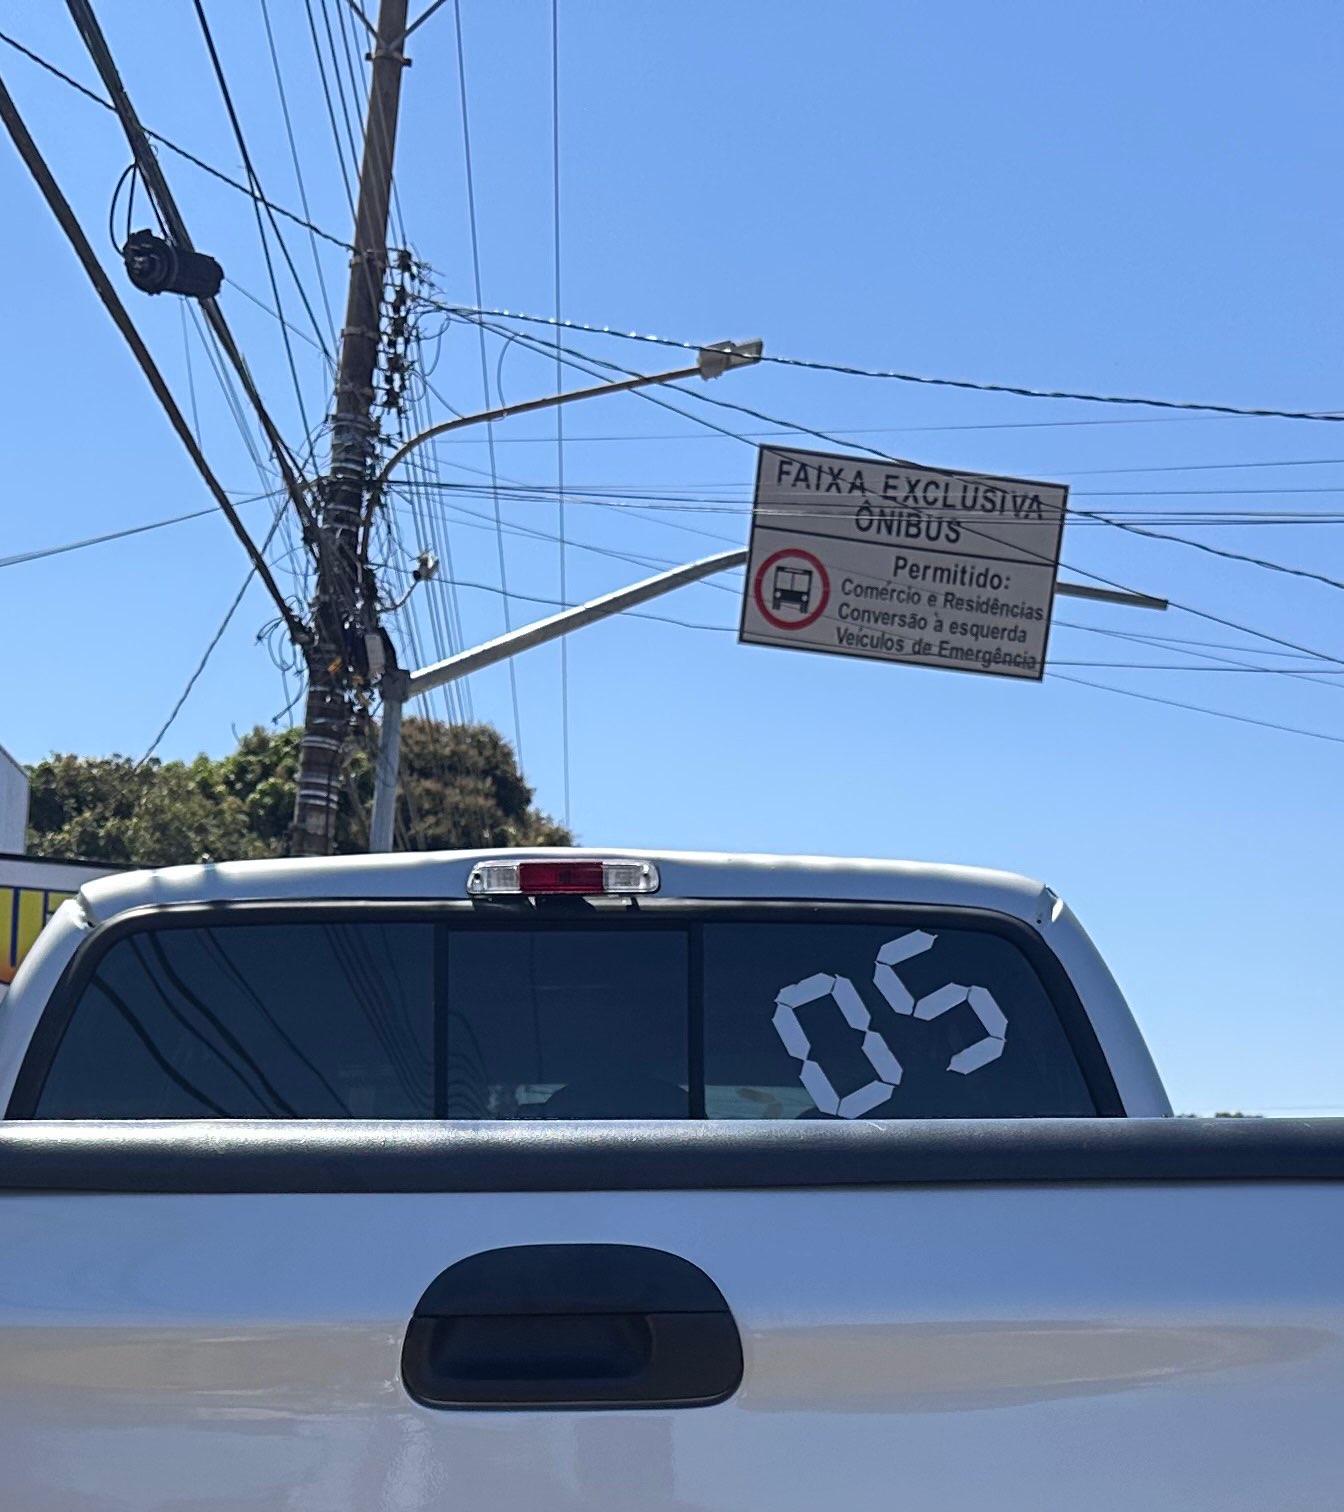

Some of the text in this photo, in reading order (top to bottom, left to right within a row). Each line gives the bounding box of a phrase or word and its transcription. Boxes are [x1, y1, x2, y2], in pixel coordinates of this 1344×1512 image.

[777, 459, 1043, 520] FAIXA EXCLUSIVA
[855, 499, 961, 543] ÔNIBUS
[893, 555, 1011, 590] Permitido:
[841, 578, 1044, 621] Comércio e Residências
[838, 602, 1027, 643] Conversão à esquerda
[836, 625, 1037, 669] Veículos de Emergência
[771, 929, 1008, 1119] 05
